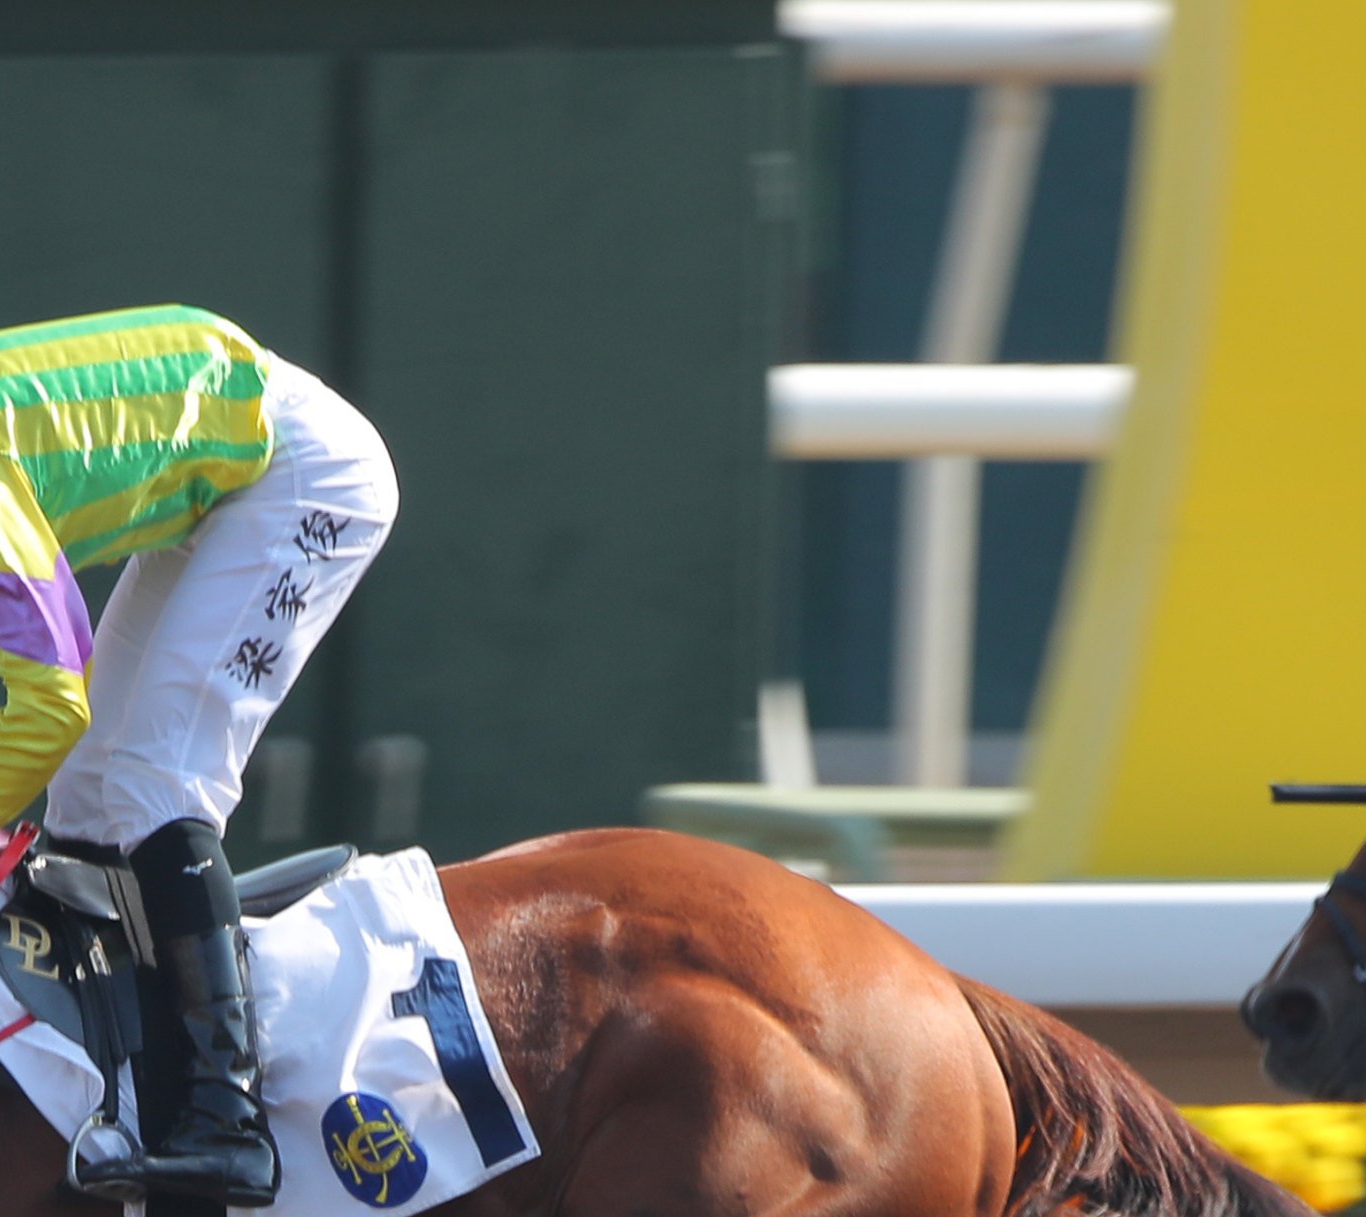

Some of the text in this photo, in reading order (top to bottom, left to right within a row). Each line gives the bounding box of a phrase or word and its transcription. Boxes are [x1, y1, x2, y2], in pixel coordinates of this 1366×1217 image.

[225, 510, 351, 689] 梁家俊
[391, 958, 528, 1169] 1
